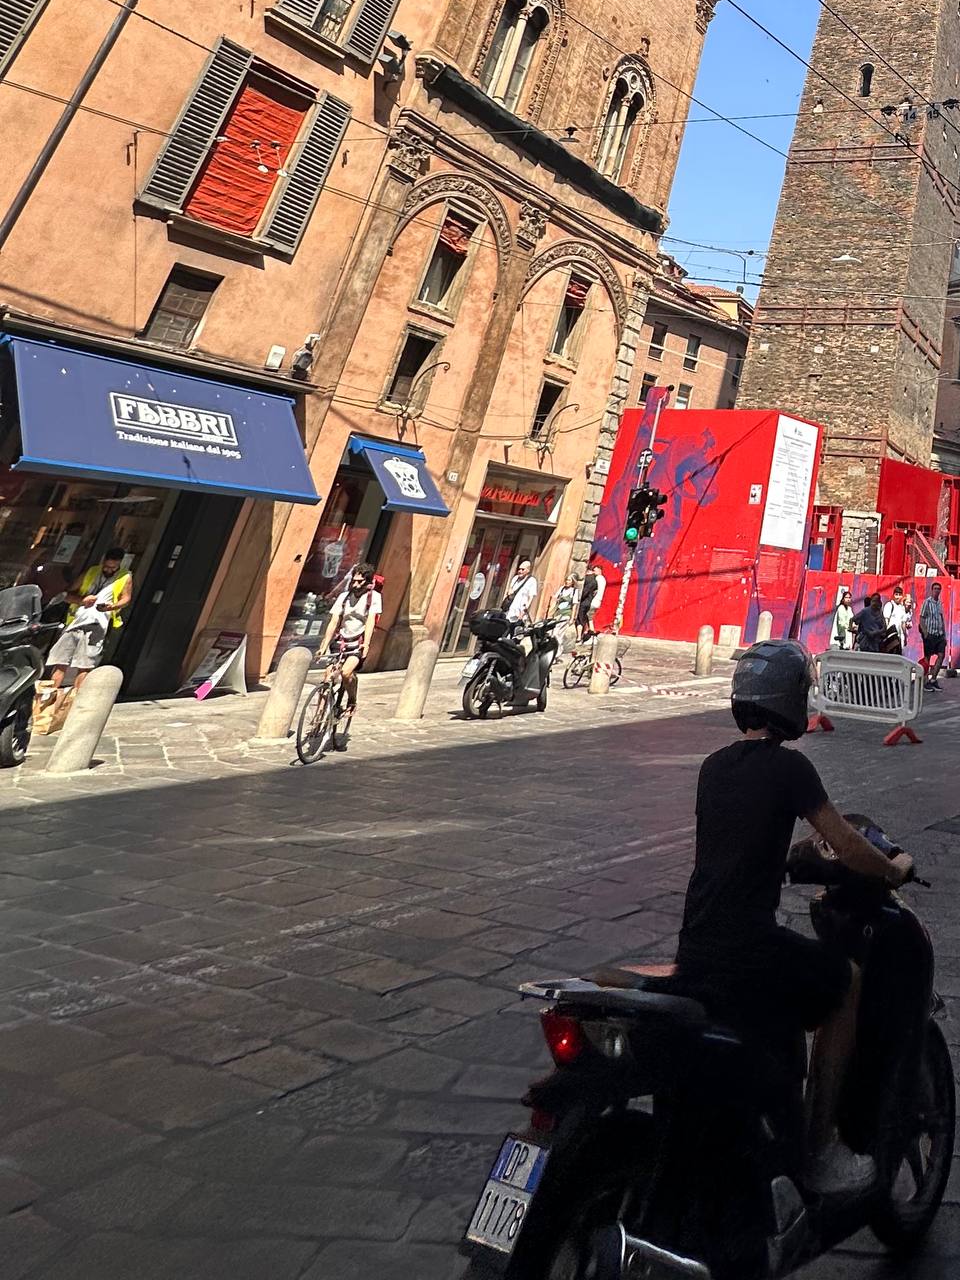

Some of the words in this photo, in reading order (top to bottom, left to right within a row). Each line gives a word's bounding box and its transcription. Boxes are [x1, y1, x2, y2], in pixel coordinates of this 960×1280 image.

[117, 398, 230, 437] FABBRI
[116, 430, 169, 447] Tradizione
[170, 439, 205, 452] italiana
[206, 445, 221, 455] dal
[475, 1191, 525, 1240] 11178
